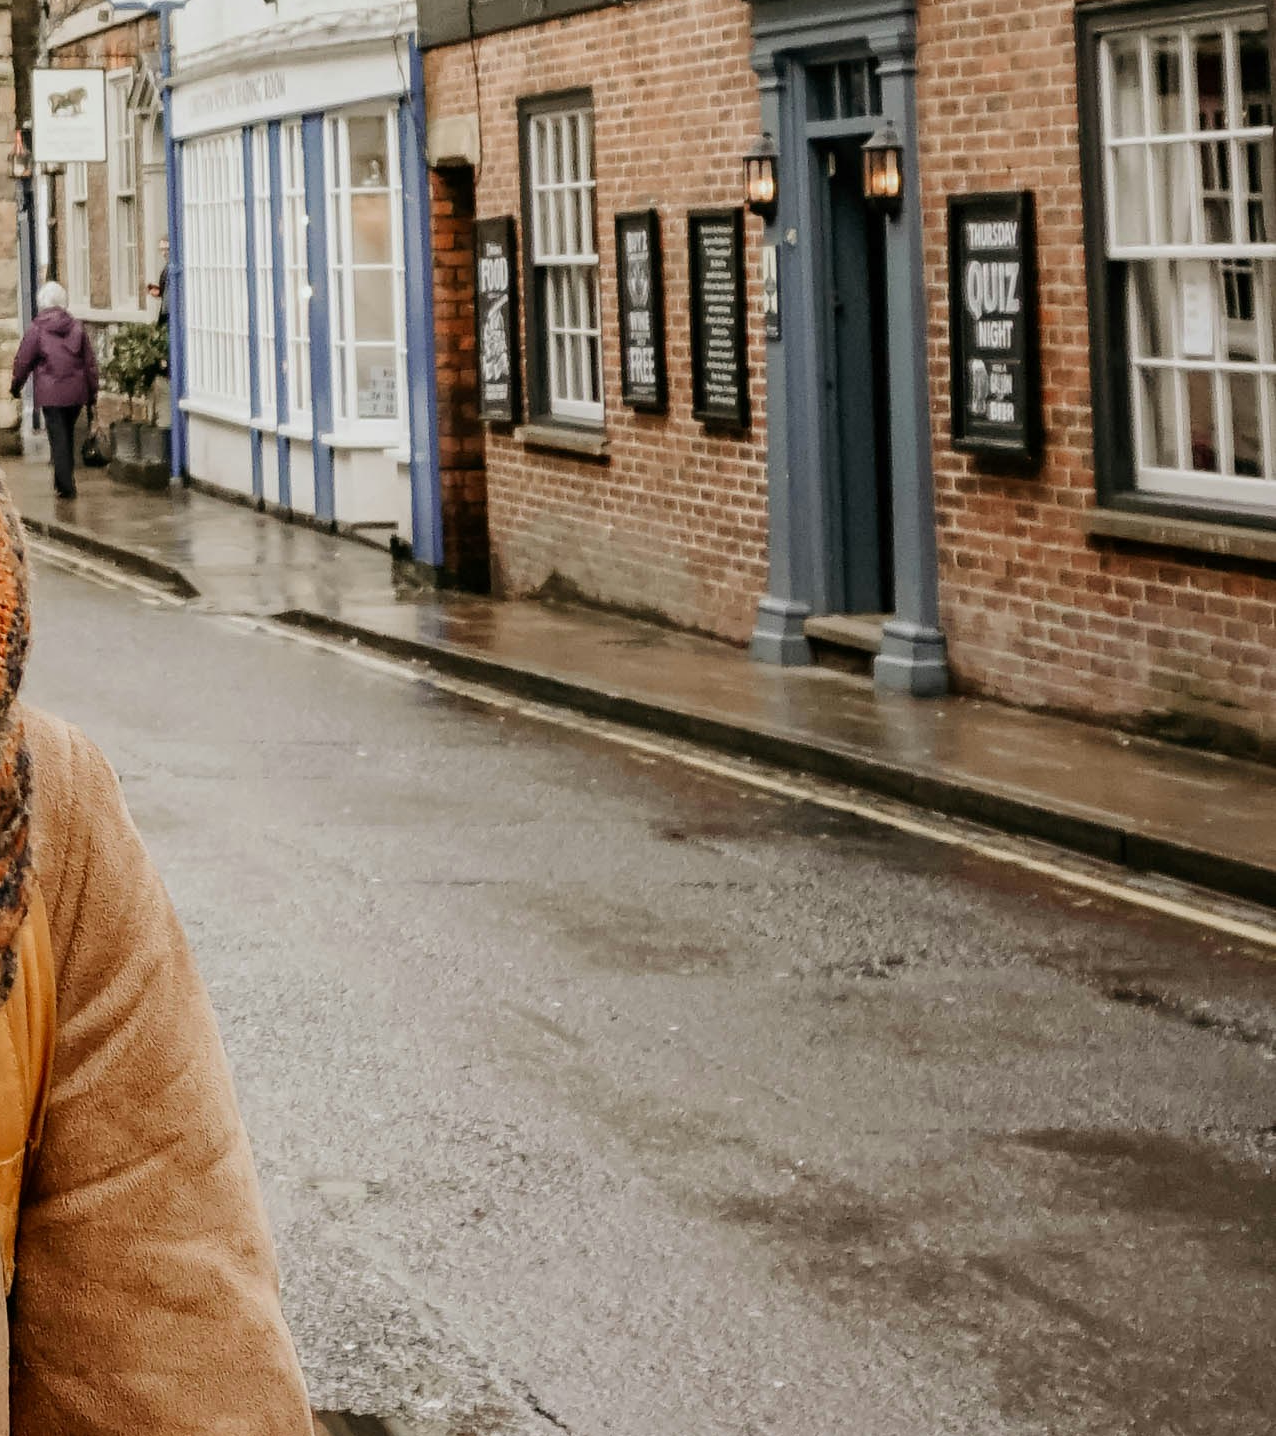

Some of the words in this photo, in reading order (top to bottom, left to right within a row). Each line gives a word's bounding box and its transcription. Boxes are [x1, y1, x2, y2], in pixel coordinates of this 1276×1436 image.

[968, 221, 1019, 248] THURSDAY
[478, 257, 509, 293] FOOD
[966, 260, 1021, 320] QUIZ
[977, 320, 1015, 349] NIGHT
